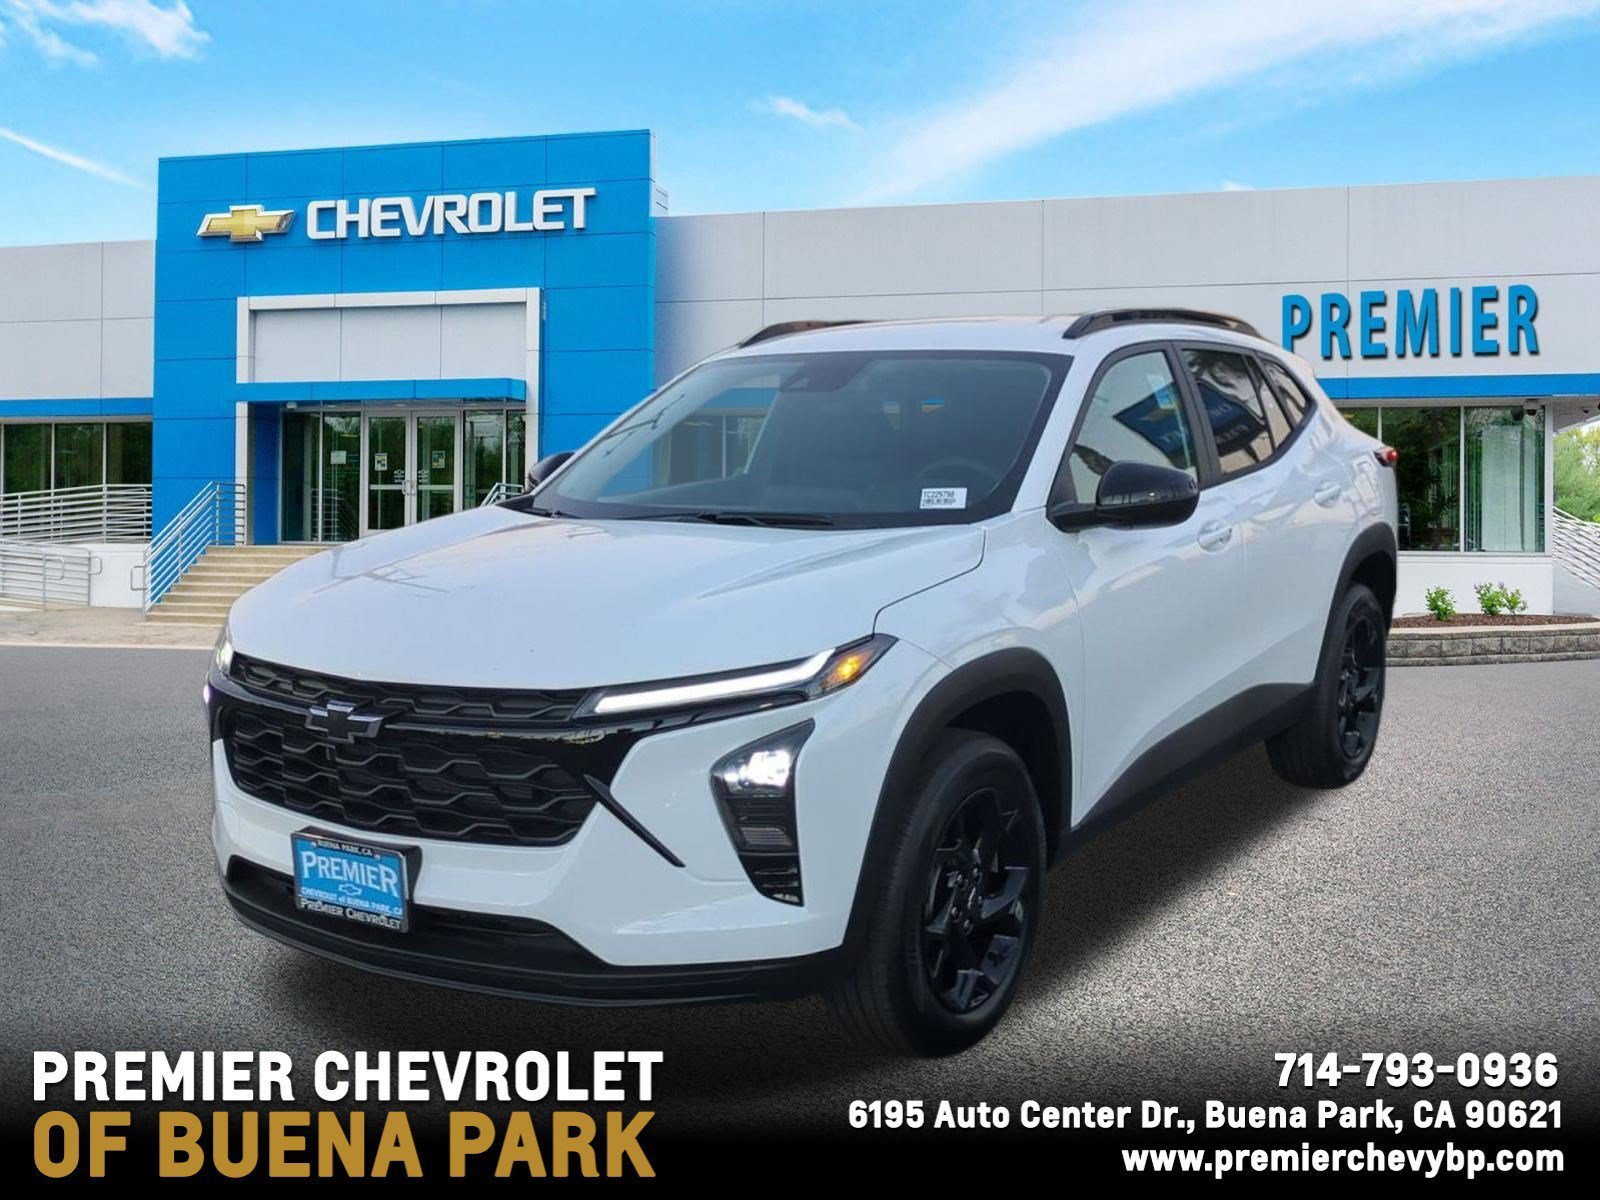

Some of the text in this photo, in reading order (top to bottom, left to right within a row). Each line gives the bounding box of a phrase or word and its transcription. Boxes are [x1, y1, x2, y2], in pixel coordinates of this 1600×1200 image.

[307, 187, 597, 240] CHEVROLET
[1281, 284, 1540, 358] PREMIER
[301, 851, 400, 898] PREMIER
